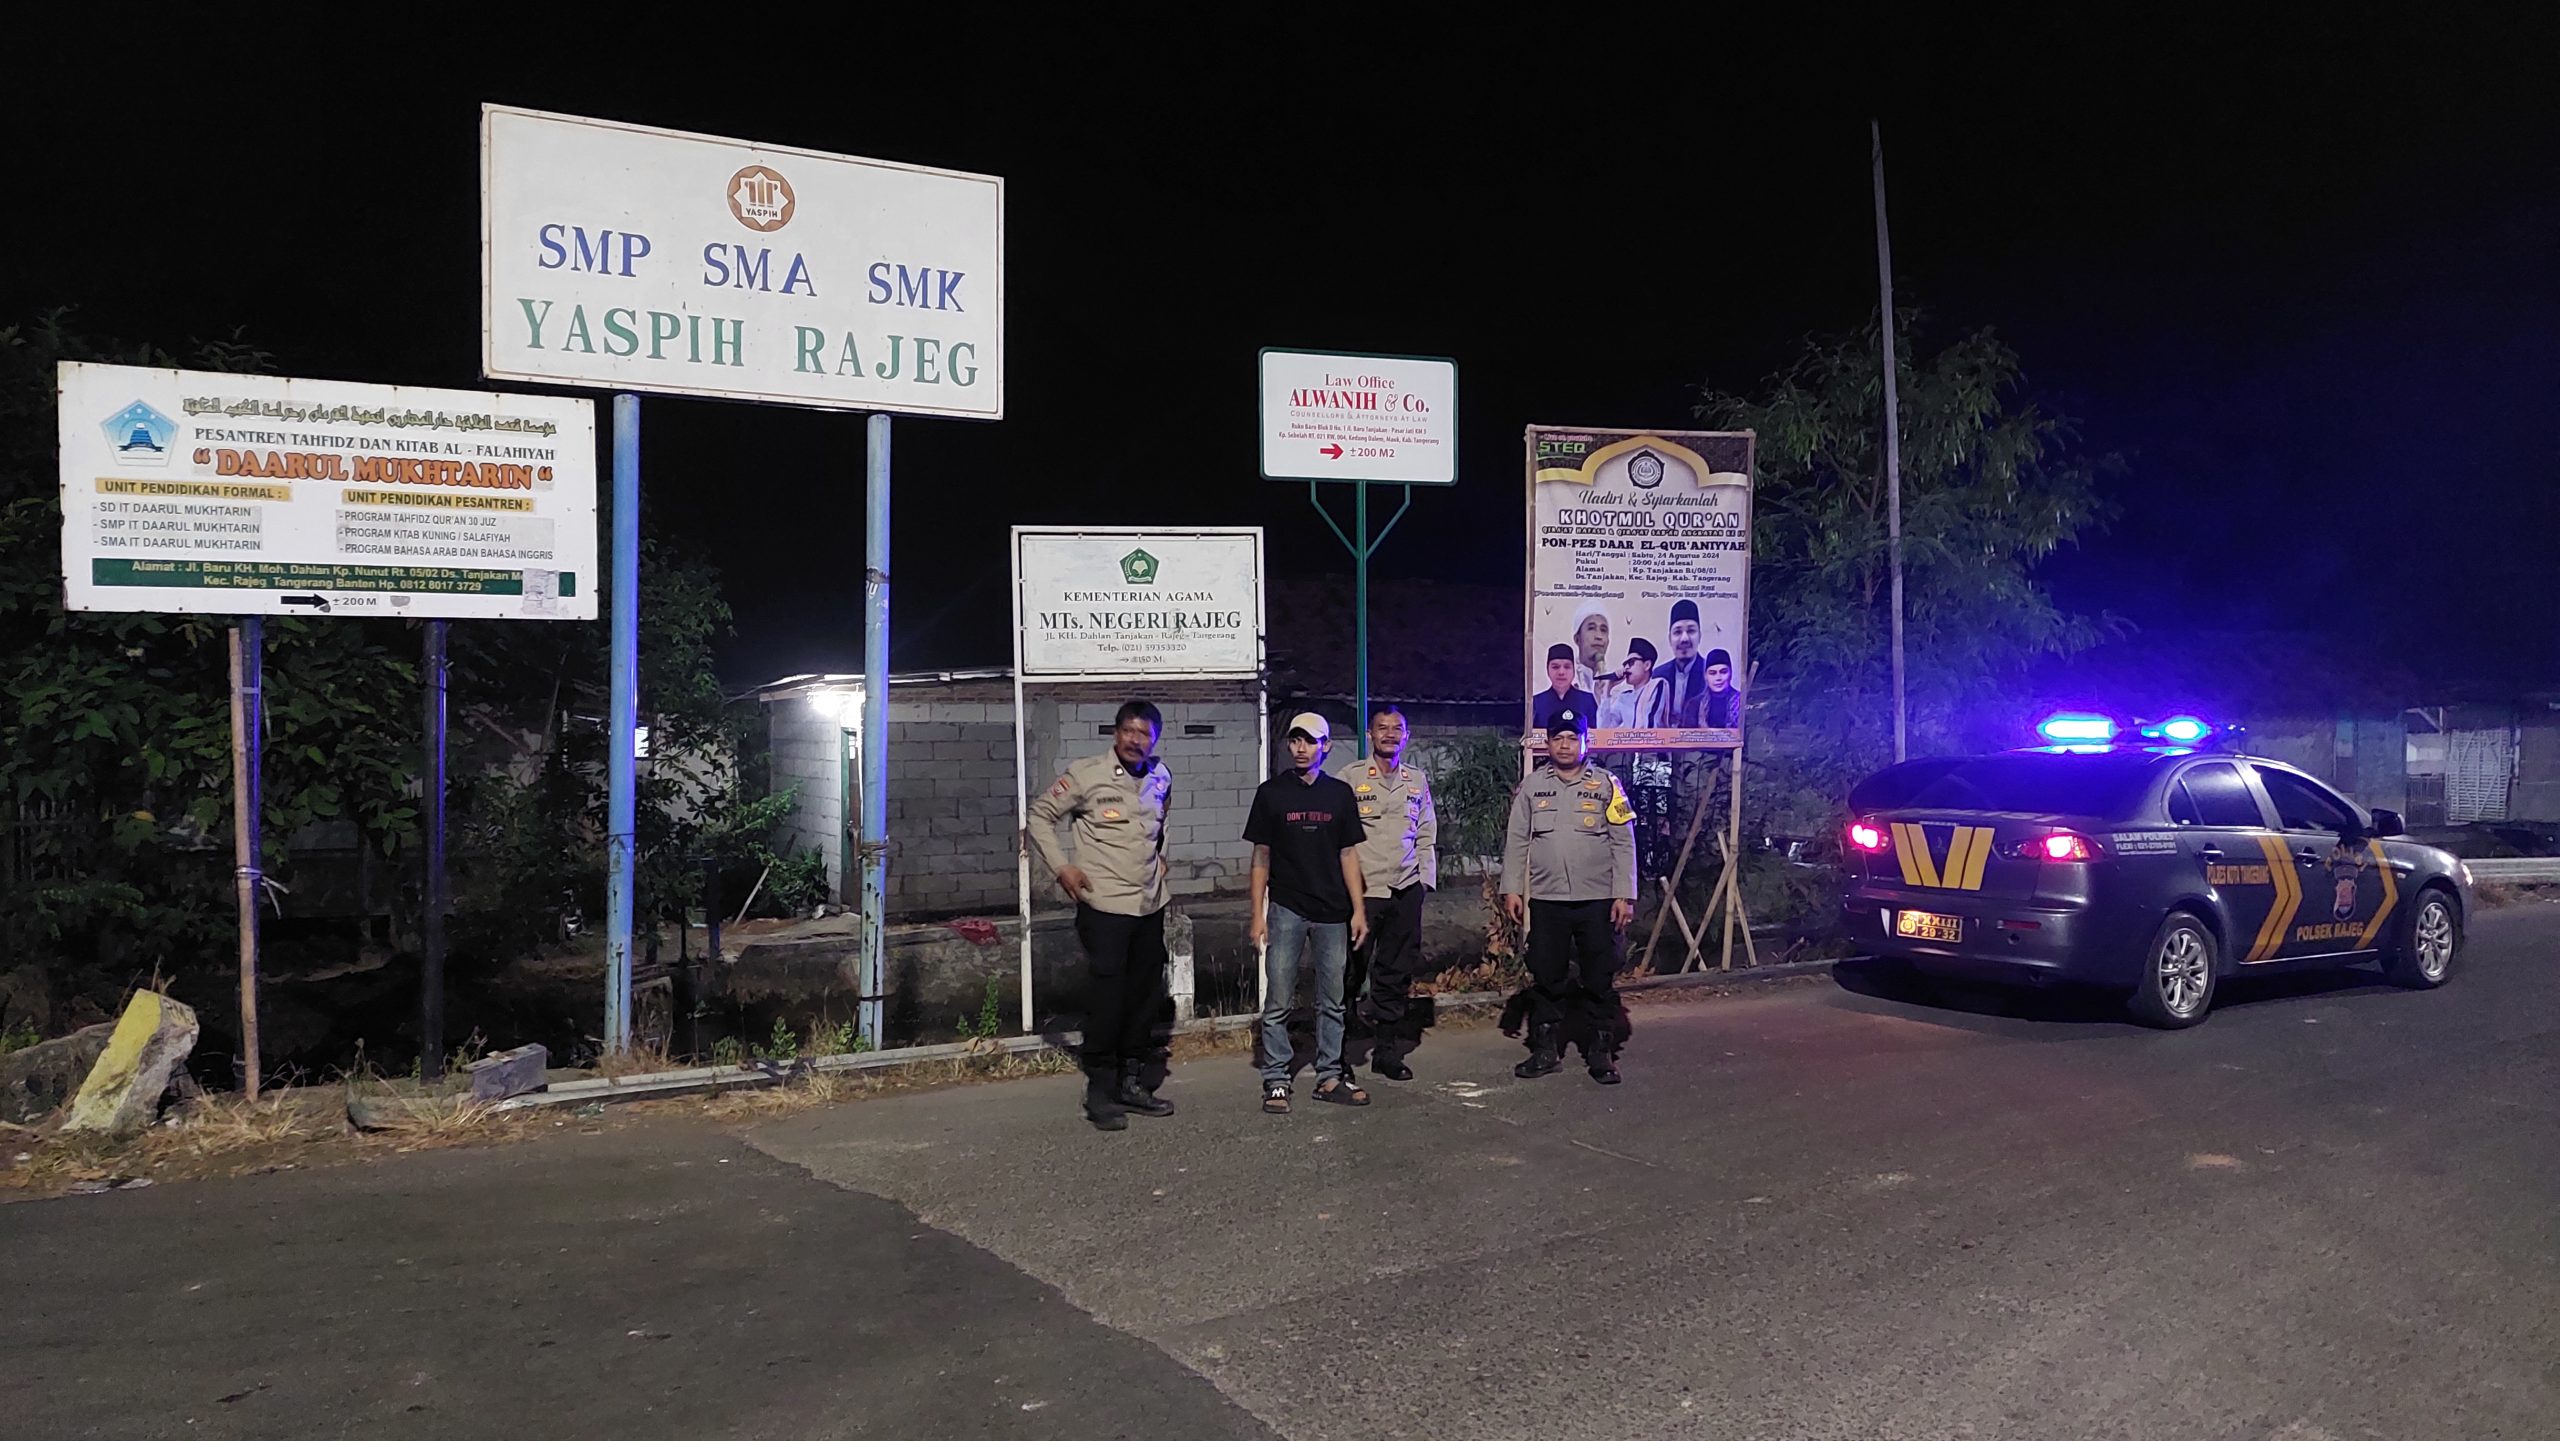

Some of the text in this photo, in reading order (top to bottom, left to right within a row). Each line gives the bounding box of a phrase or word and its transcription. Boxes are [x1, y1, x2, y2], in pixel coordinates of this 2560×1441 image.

[745, 207, 779, 218] YASPIH
[537, 223, 967, 313] SMP SMA SMK
[517, 297, 979, 388] YASPIH RAJEG
[1325, 373, 1395, 389] Law Office
[1288, 389, 1430, 413] ALWANIH & Co.
[195, 428, 555, 460] PESANTREN TAHFIDZ DAN KITAB AL FALAHIYAH
[1379, 448, 1395, 458] M2
[215, 448, 534, 490] DAARUL MUKHTARIN
[104, 481, 275, 499] UNIT PENDIDIKAN FORMAL
[347, 492, 523, 510] UNIT PENDIDIKAN PESANTREN
[1627, 492, 1638, 507] &
[99, 502, 251, 517] SD IT DAARUL MUKHTARIN
[100, 519, 260, 534] SMP IT DAARUL MUKHTARIN
[344, 511, 497, 527] PROGRAM TAHFIDZ QUR'AN 30 JUZ
[1559, 509, 1740, 531] KHOTMIL QUR'AN
[100, 536, 261, 550] SMA IT DAARUL MUKHTARIN
[344, 528, 511, 543] PROGRAM KITAB KUNING SALAFIYAH
[1541, 537, 1746, 551] PON-PES DAAR EL-QUR'ANIYYAH
[344, 544, 553, 560] PROGRAM BAHASA ARAB DAN BAHASA INGGRIS
[132, 562, 176, 572] Alamat
[185, 563, 199, 573] Jl.
[203, 563, 231, 573] Baru
[234, 564, 256, 574] KH.
[259, 565, 284, 574] Moh.
[290, 565, 330, 575] Dahlan
[332, 566, 350, 579] Kp.
[410, 568, 438, 579] 05/02
[462, 569, 509, 582] Tanjakan
[233, 577, 267, 588] Rajeg
[272, 577, 334, 590] Tangerang
[336, 579, 377, 589] Banten
[378, 579, 398, 591] Hp.
[400, 580, 426, 590] 0812
[428, 581, 454, 590] 8017
[456, 581, 482, 591] 3729
[342, 597, 364, 606] 200
[1063, 591, 1214, 602] KEMENTERIAN AGAMA
[1039, 611, 1241, 630] MTs. NEGERI RAJEG
[1080, 632, 1111, 640] Dahlan
[1114, 631, 1153, 641] Tanjakan
[1161, 632, 1185, 640] Rajeg
[1192, 632, 1236, 640] Tangerang
[1096, 643, 1119, 652] Telp.
[1121, 644, 1142, 652] (021)
[1576, 791, 1602, 800] POLRI
[1286, 812, 1306, 821] DON'T
[2296, 923, 2334, 942] POLSEK
